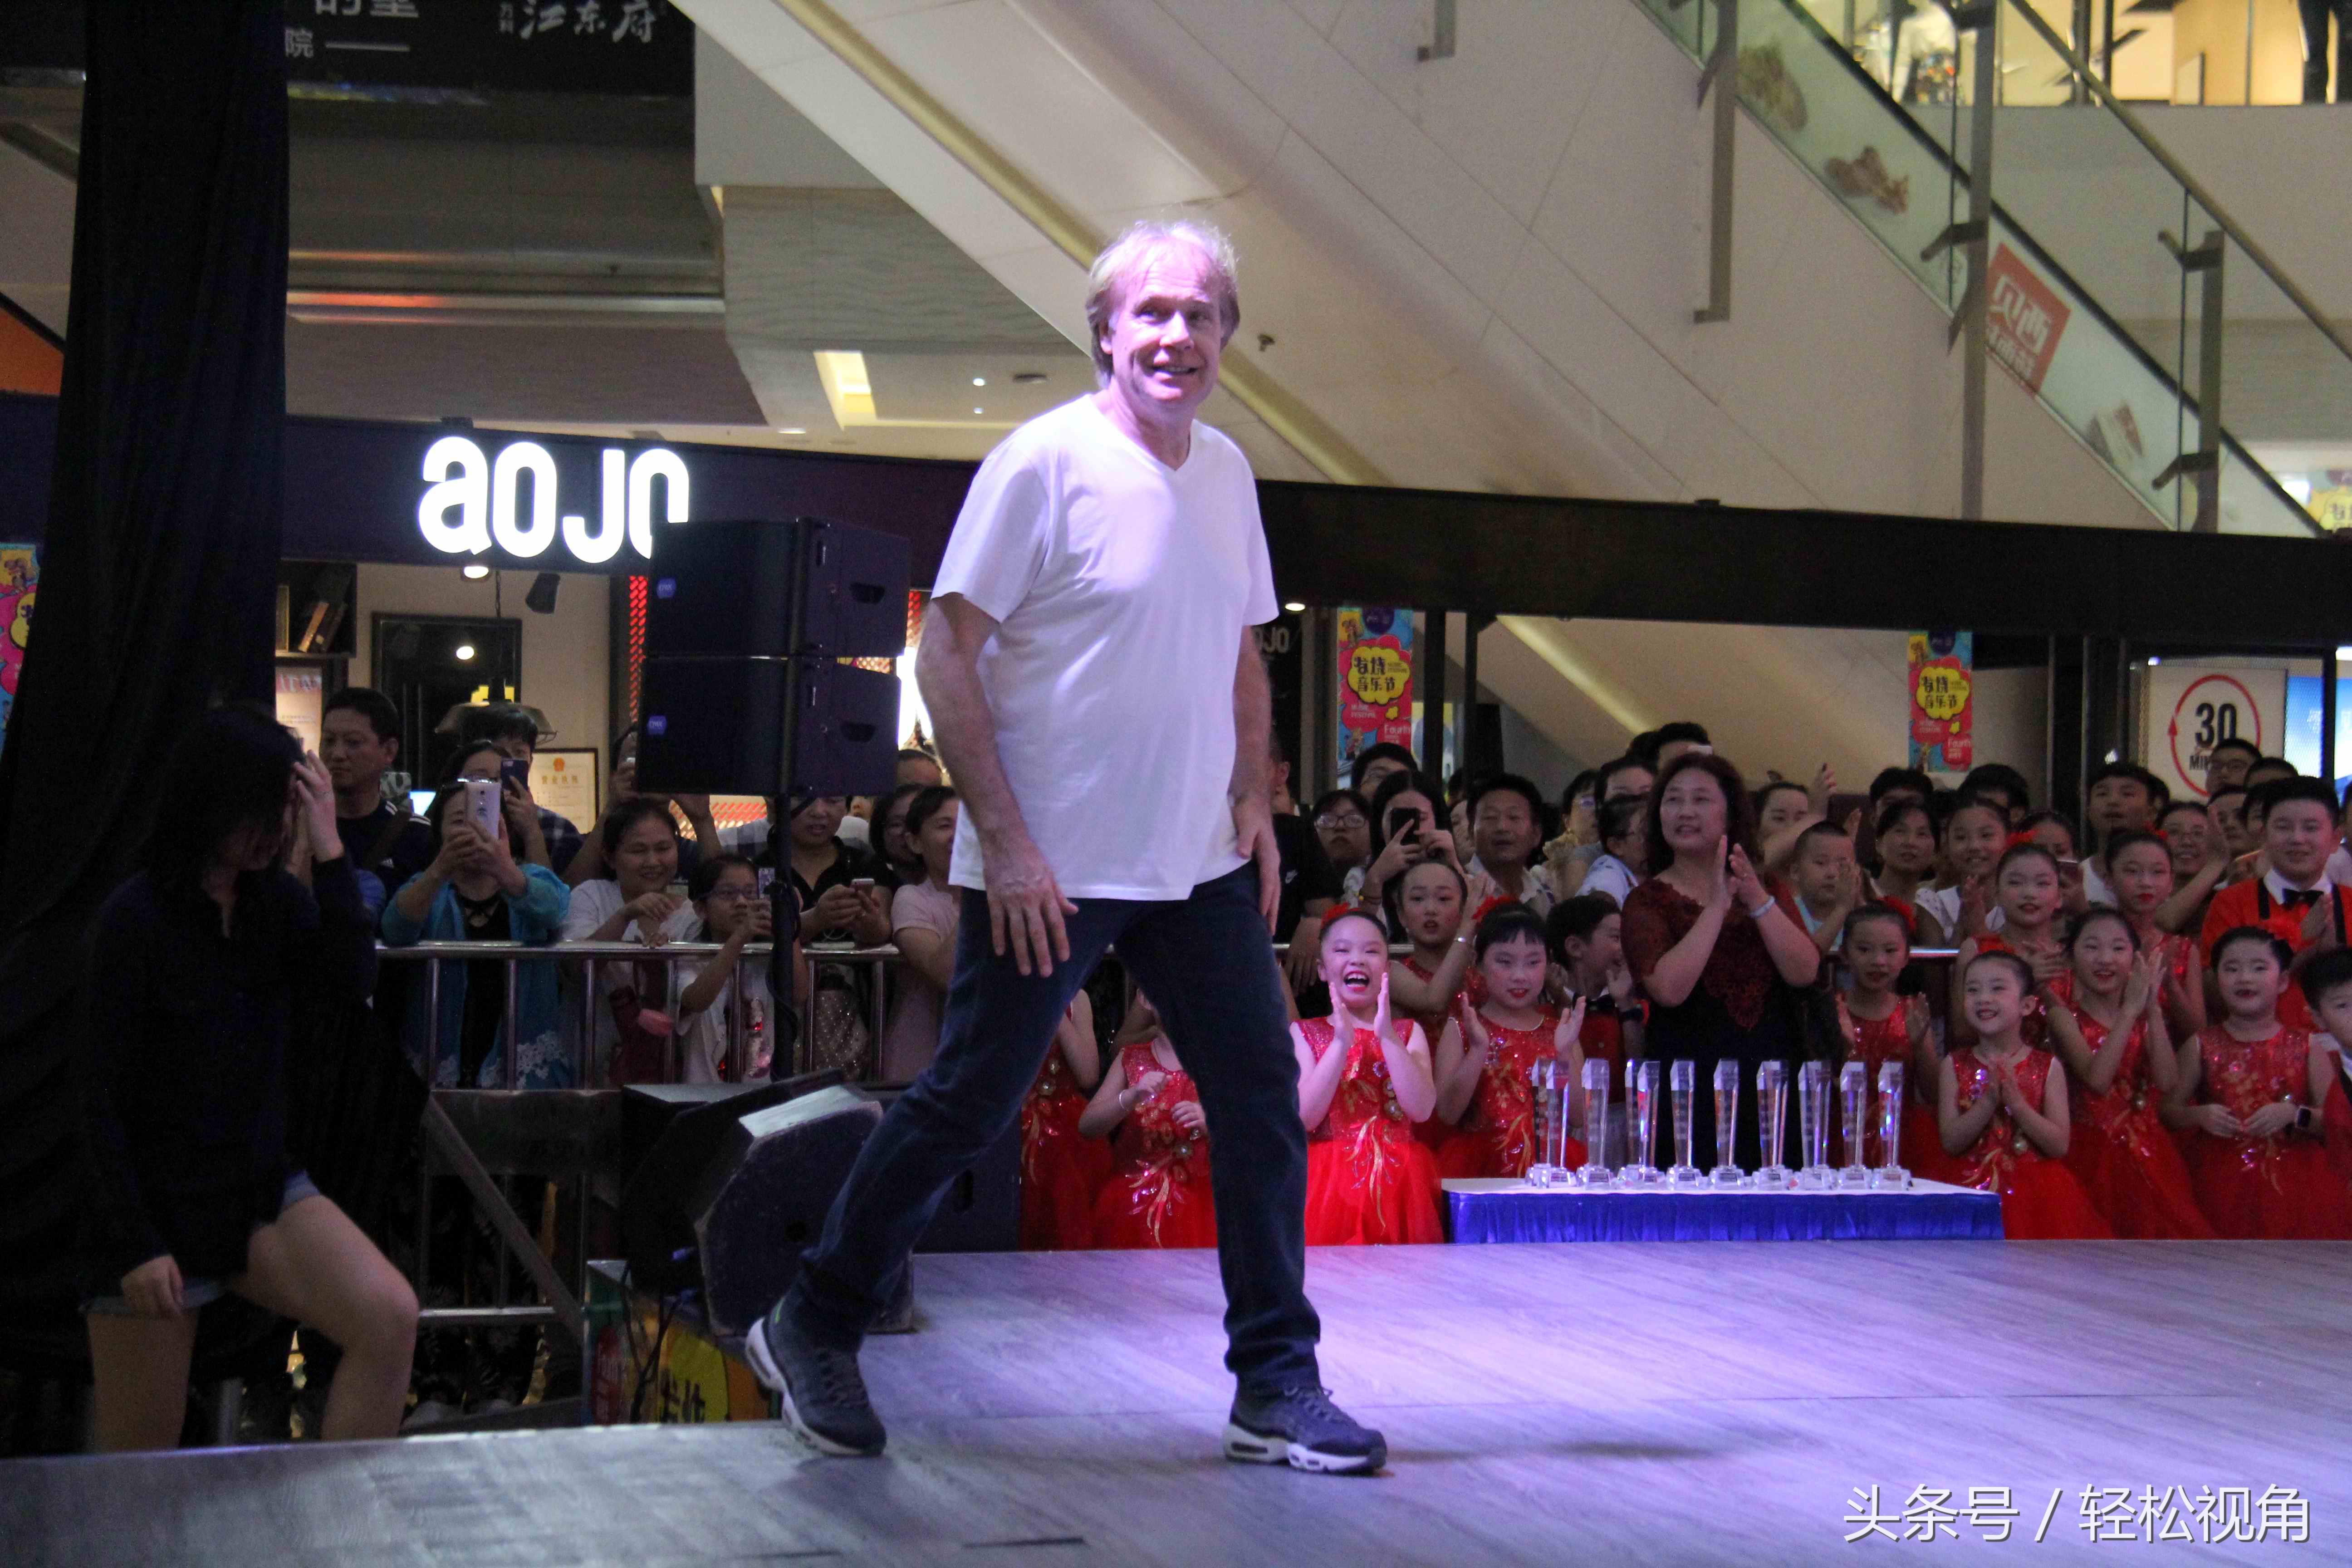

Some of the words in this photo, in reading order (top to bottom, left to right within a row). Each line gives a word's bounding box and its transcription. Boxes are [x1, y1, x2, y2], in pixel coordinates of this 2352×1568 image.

[519, 0, 655, 43] 江东府
[1357, 677, 1396, 691] 音乐节
[2195, 702, 2237, 750] 30
